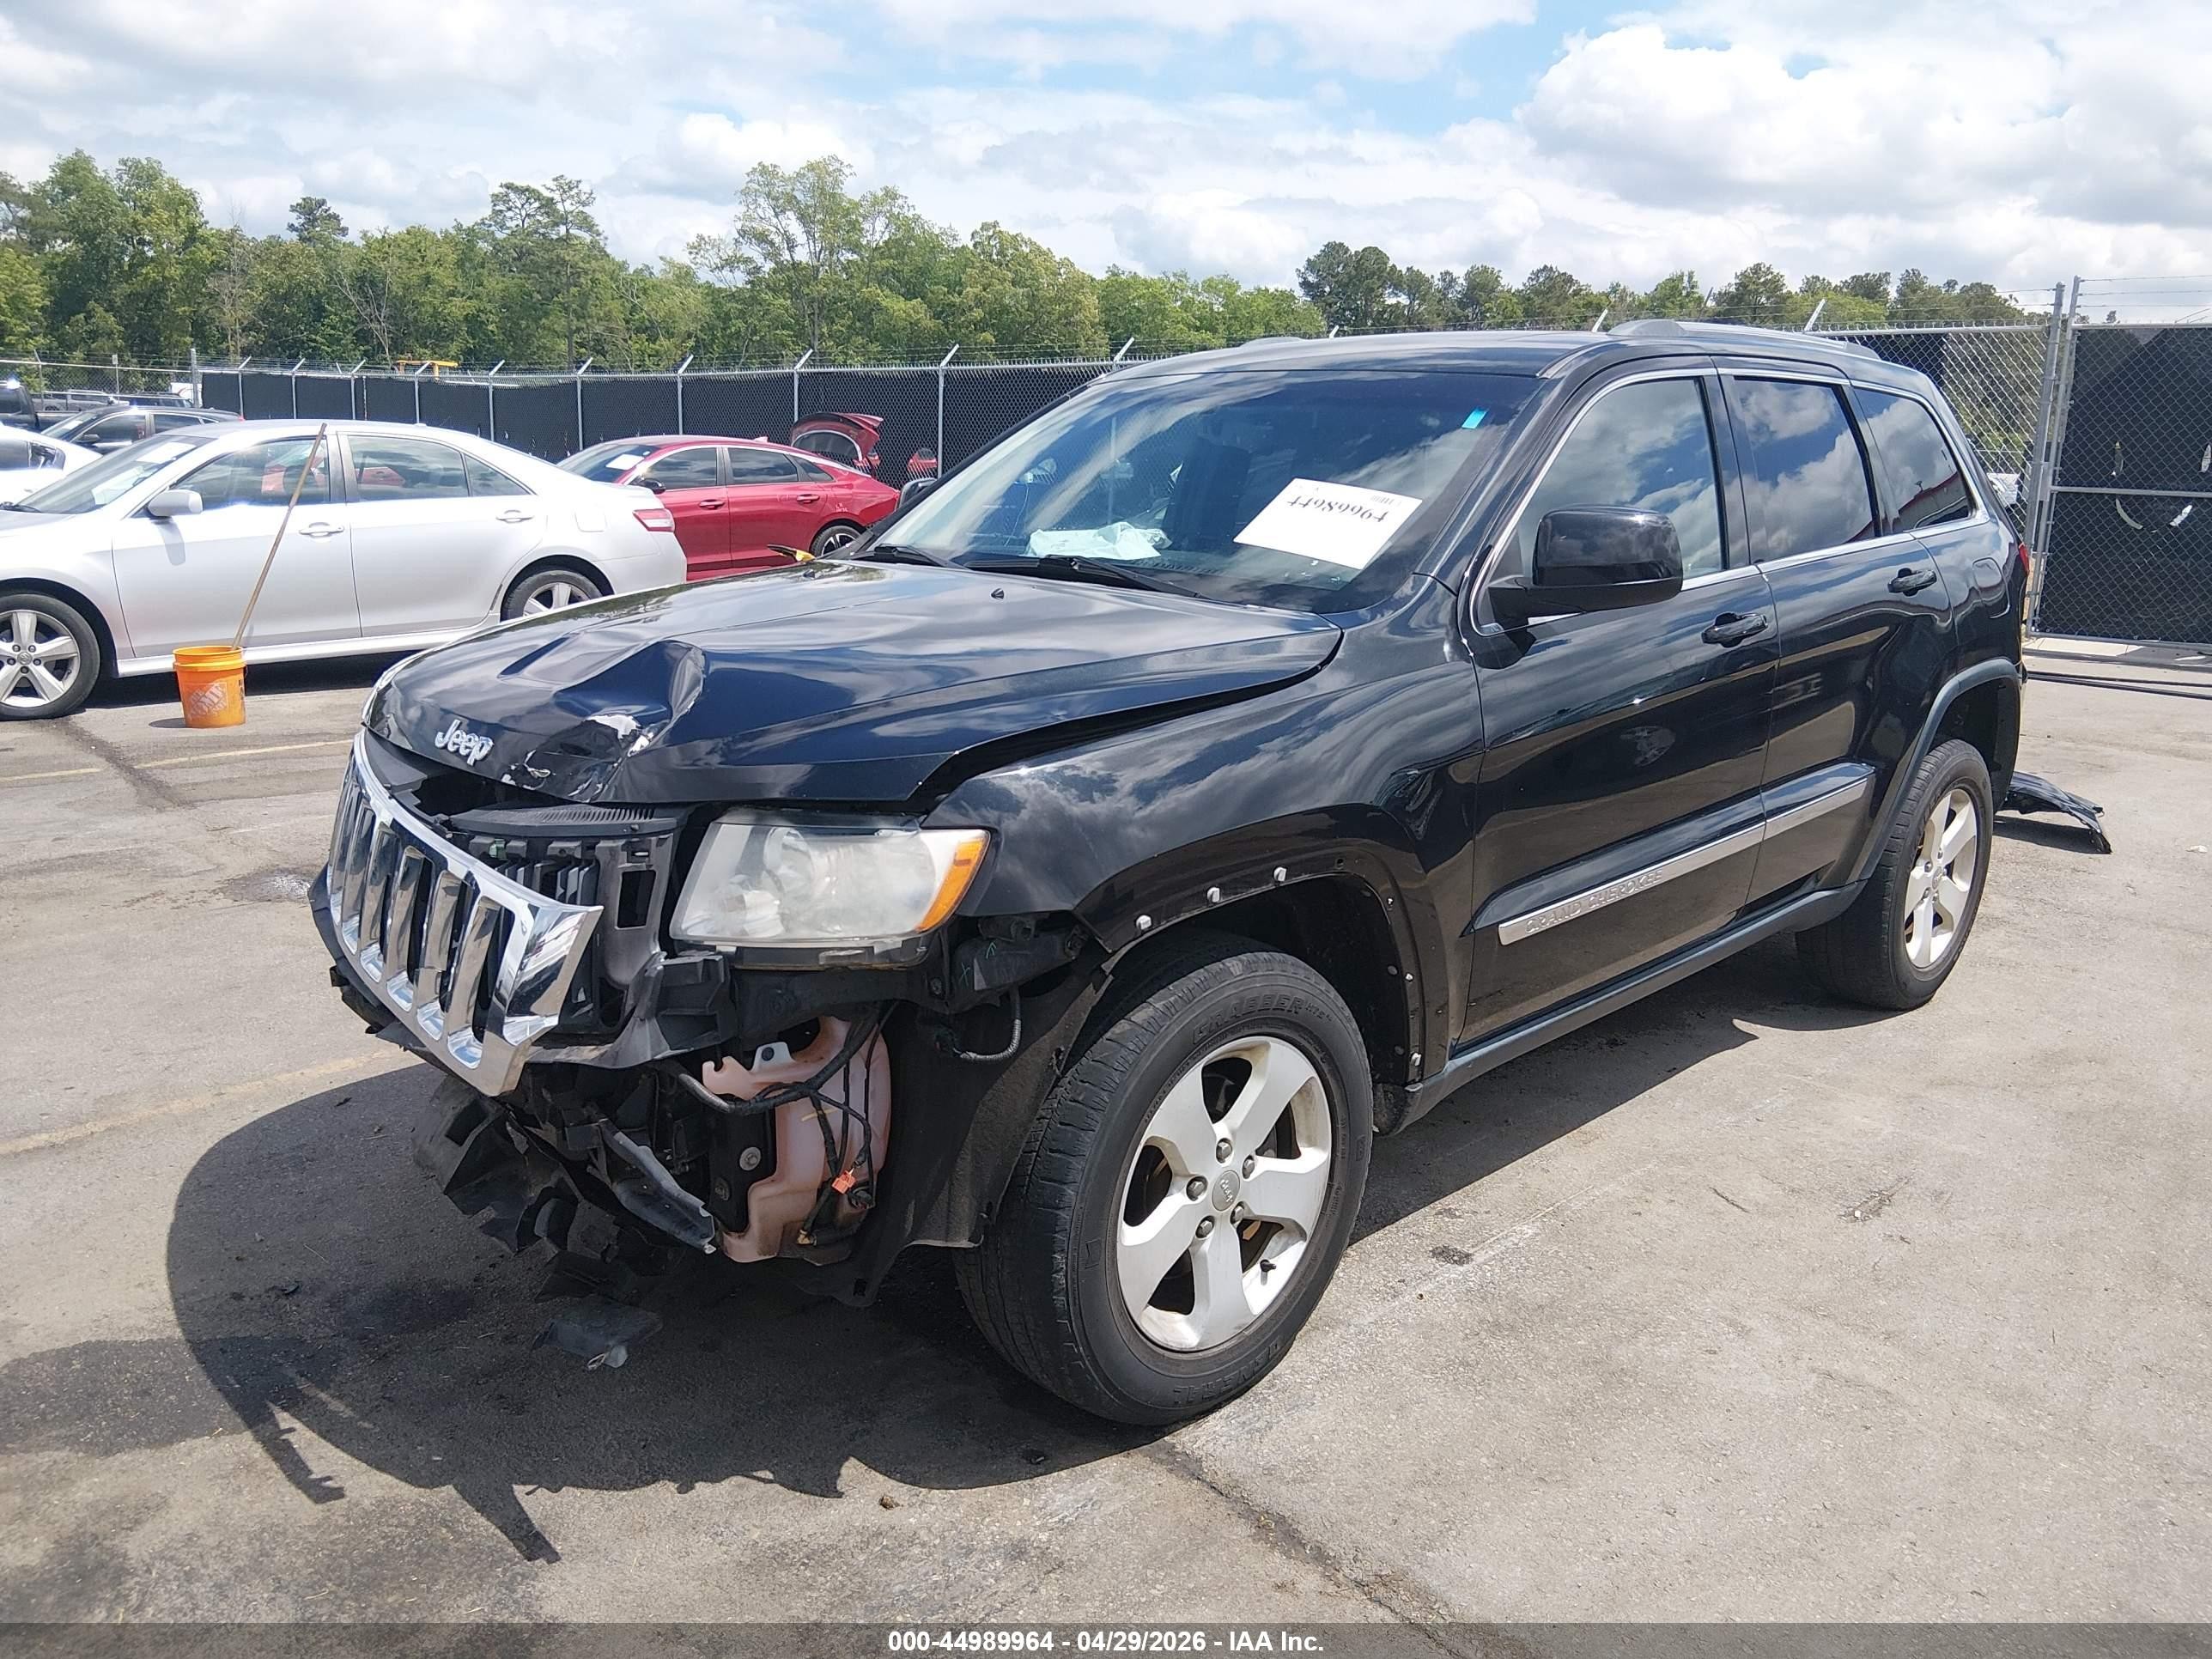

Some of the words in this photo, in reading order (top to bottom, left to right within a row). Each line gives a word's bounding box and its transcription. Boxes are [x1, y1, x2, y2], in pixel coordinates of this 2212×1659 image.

[1286, 495, 1389, 523] 44989964
[434, 719, 495, 767] Jeep
[1525, 902, 1582, 933] GRAND
[1588, 870, 1662, 909] CHEROKEE
